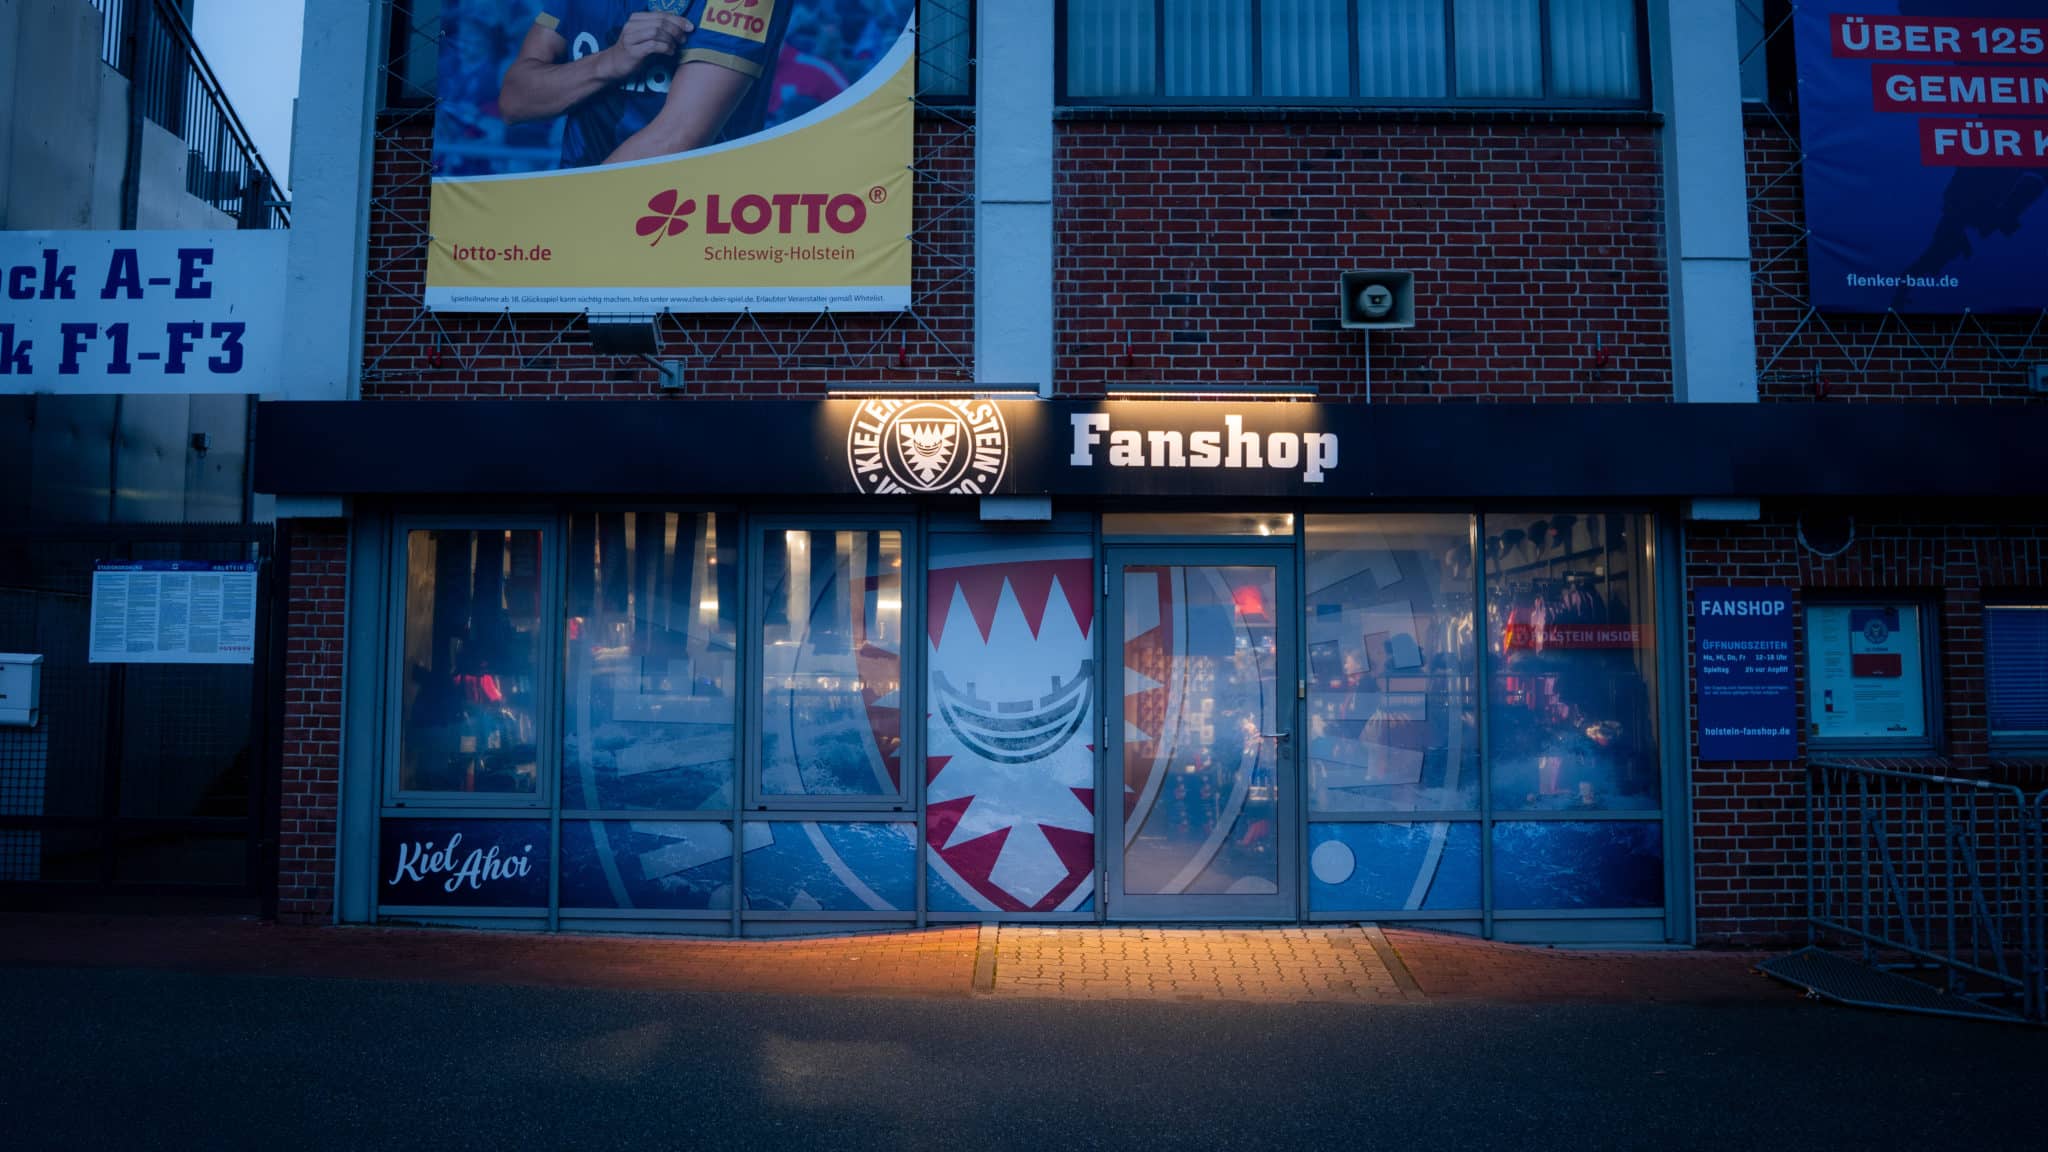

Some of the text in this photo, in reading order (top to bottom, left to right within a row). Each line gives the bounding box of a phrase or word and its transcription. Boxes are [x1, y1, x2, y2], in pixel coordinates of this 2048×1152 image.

[706, 7, 765, 33] LOTTO
[1841, 16, 2045, 55] ÜBER 125
[1934, 121, 2023, 156] FÜR
[453, 243, 552, 262] lotto-sh.de
[703, 245, 856, 263] Schleswig-Holstein
[0, 248, 214, 300] ck A-E
[1846, 273, 1959, 288] flenker-bau.de
[501, 295, 510, 303] ab
[559, 295, 576, 303] kann
[578, 295, 602, 304] süchtig
[58, 321, 246, 375] F1-F3
[1069, 412, 1339, 483] Fanshop
[1700, 600, 1785, 617] FANSHOP
[1531, 631, 1640, 642] HOLSTEIN INSIDE
[1702, 639, 1788, 650] ÖFFNUNGSZEITEN
[1703, 666, 1729, 675] Spieltag
[1767, 666, 1789, 675] Anpfiff
[1704, 727, 1791, 737] holstein-fanshop.de
[388, 832, 533, 893] Kiel Ahoi
